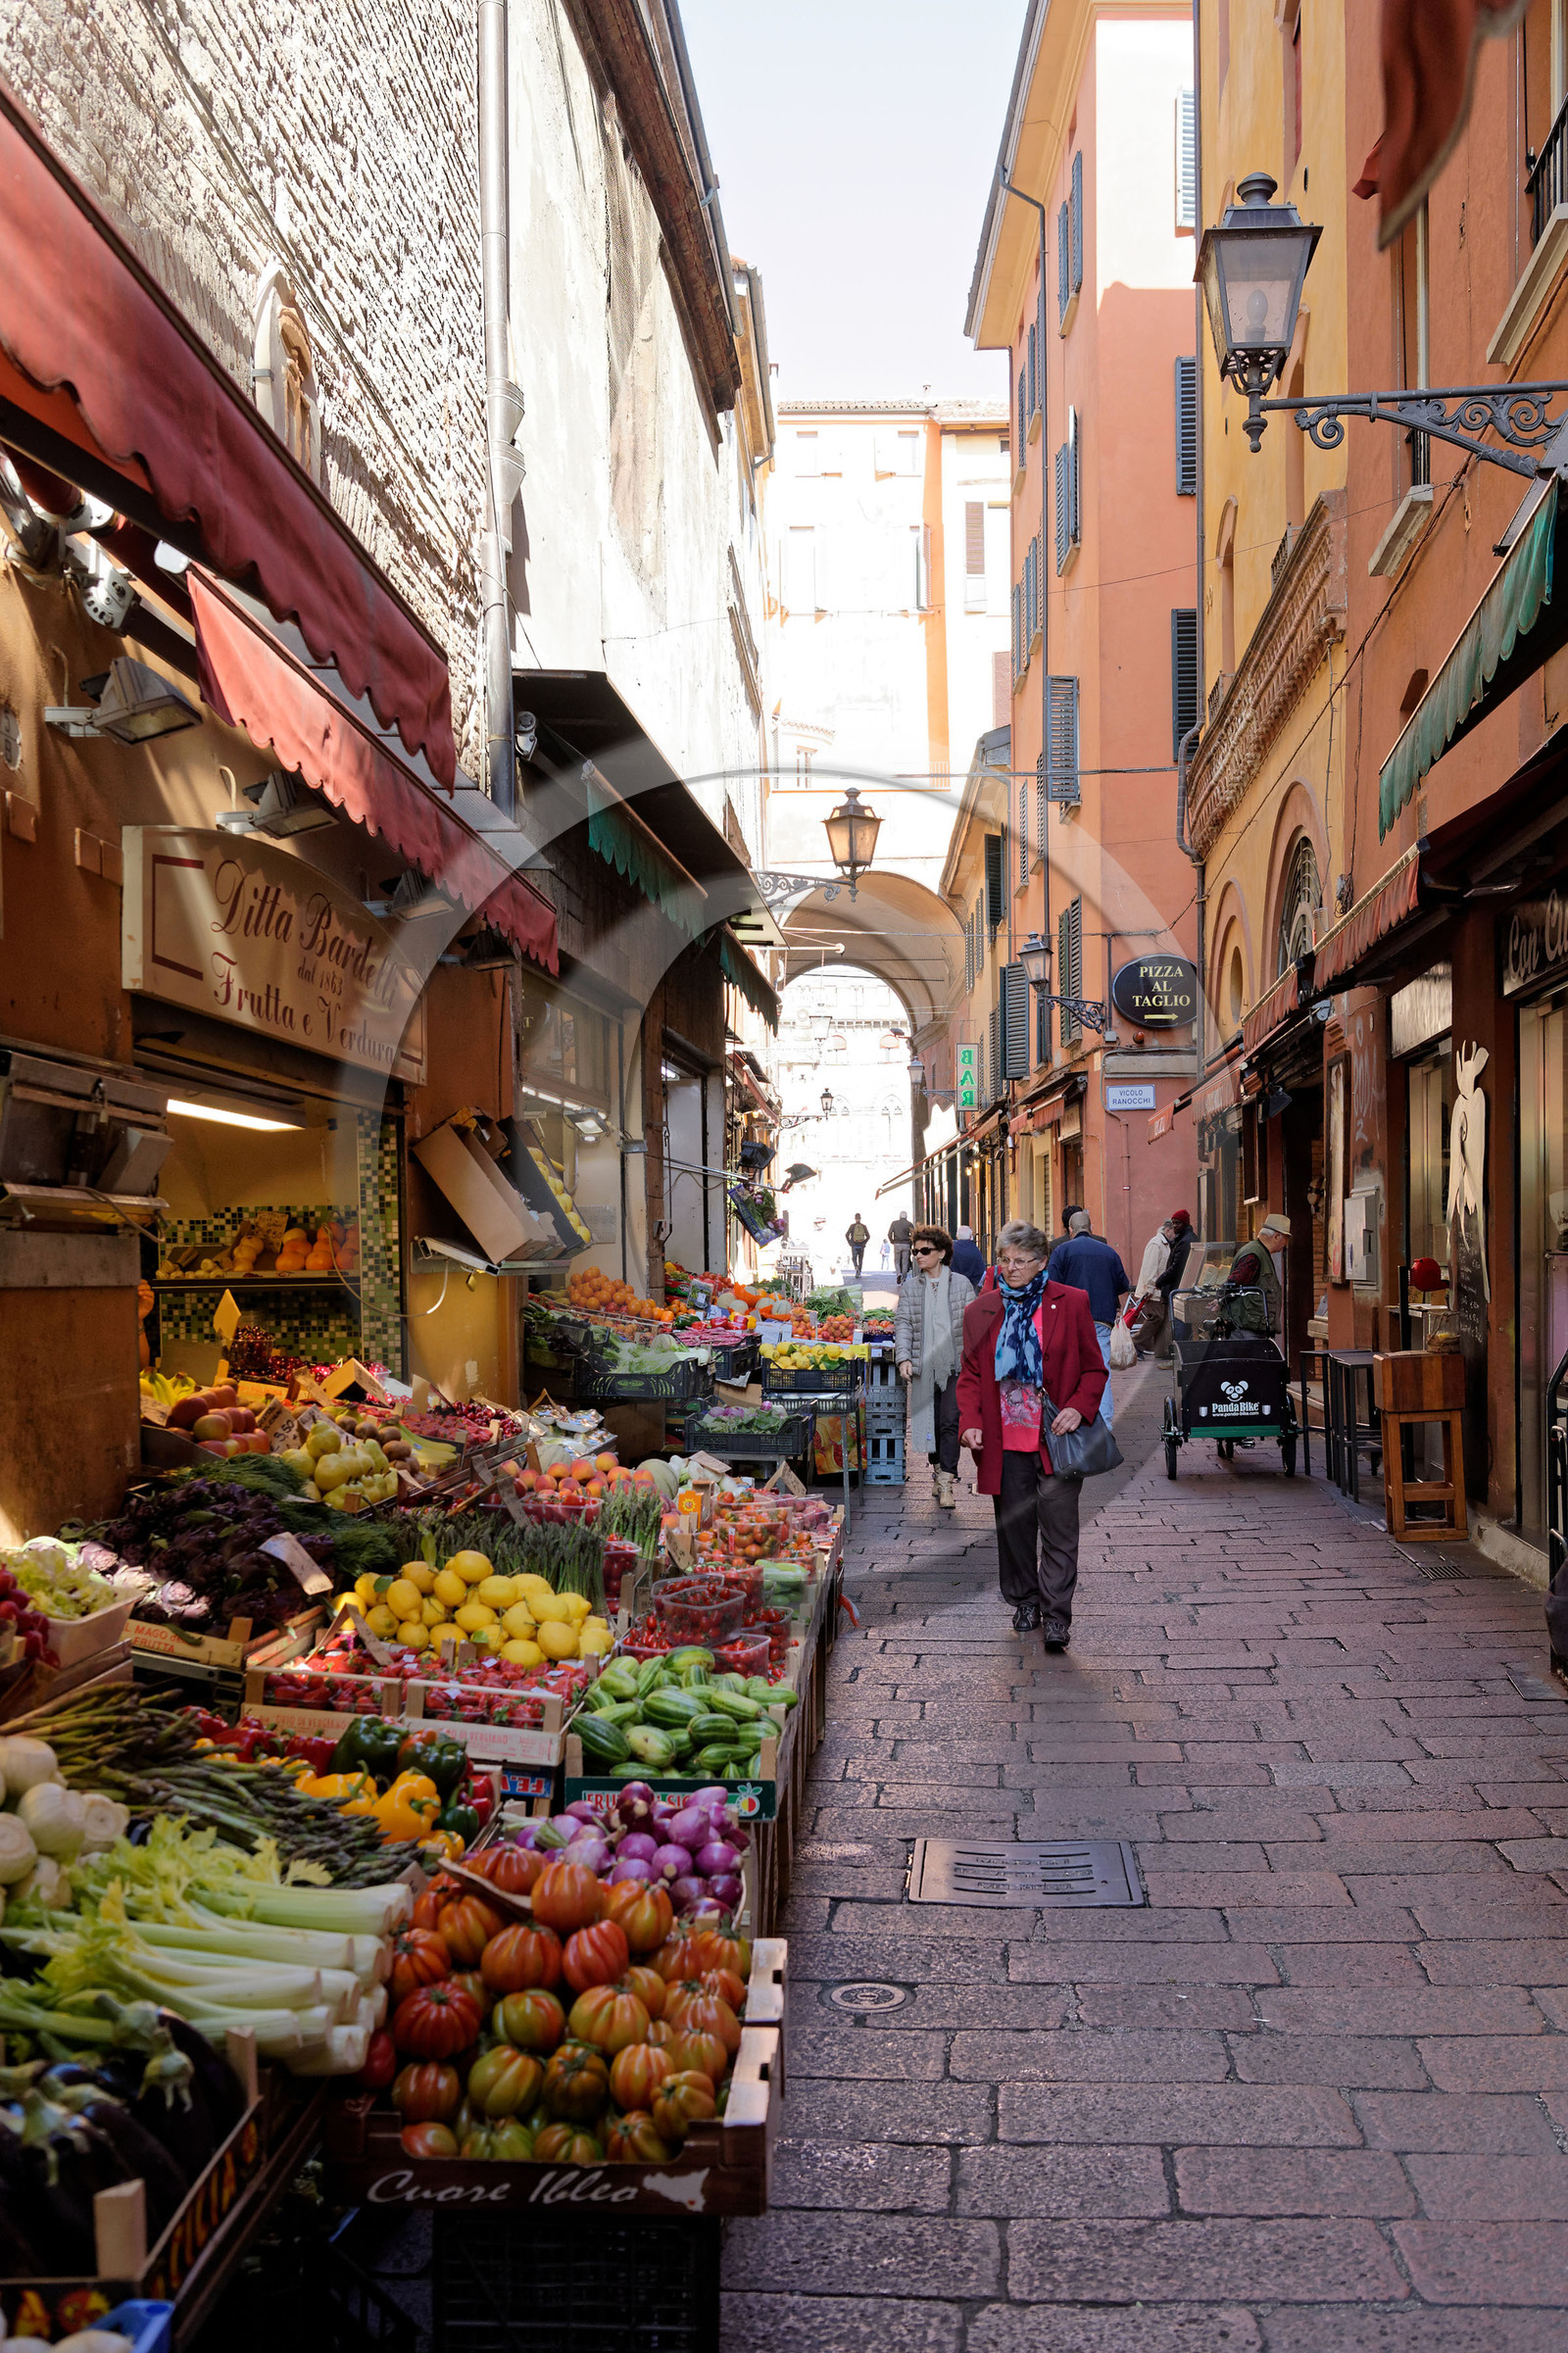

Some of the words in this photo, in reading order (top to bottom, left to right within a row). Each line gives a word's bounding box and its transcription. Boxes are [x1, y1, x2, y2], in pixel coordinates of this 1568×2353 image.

[211, 859, 294, 944] Ditta
[299, 893, 398, 1010] Bardelli
[1508, 914, 1540, 982] Con
[298, 957, 317, 985] dal
[319, 969, 342, 997] 1863
[1139, 965, 1184, 978] PIZZA
[1151, 980, 1172, 992] AL
[211, 951, 295, 1030] Frutta
[302, 1012, 313, 1036] e
[318, 996, 395, 1067] Verdura
[1132, 995, 1191, 1006] TAGLIO
[132, 1637, 175, 1654] FRUTTA
[133, 1625, 169, 1641] MAGO
[367, 2169, 512, 2203] Cuore
[528, 2169, 639, 2205] Ibleo
